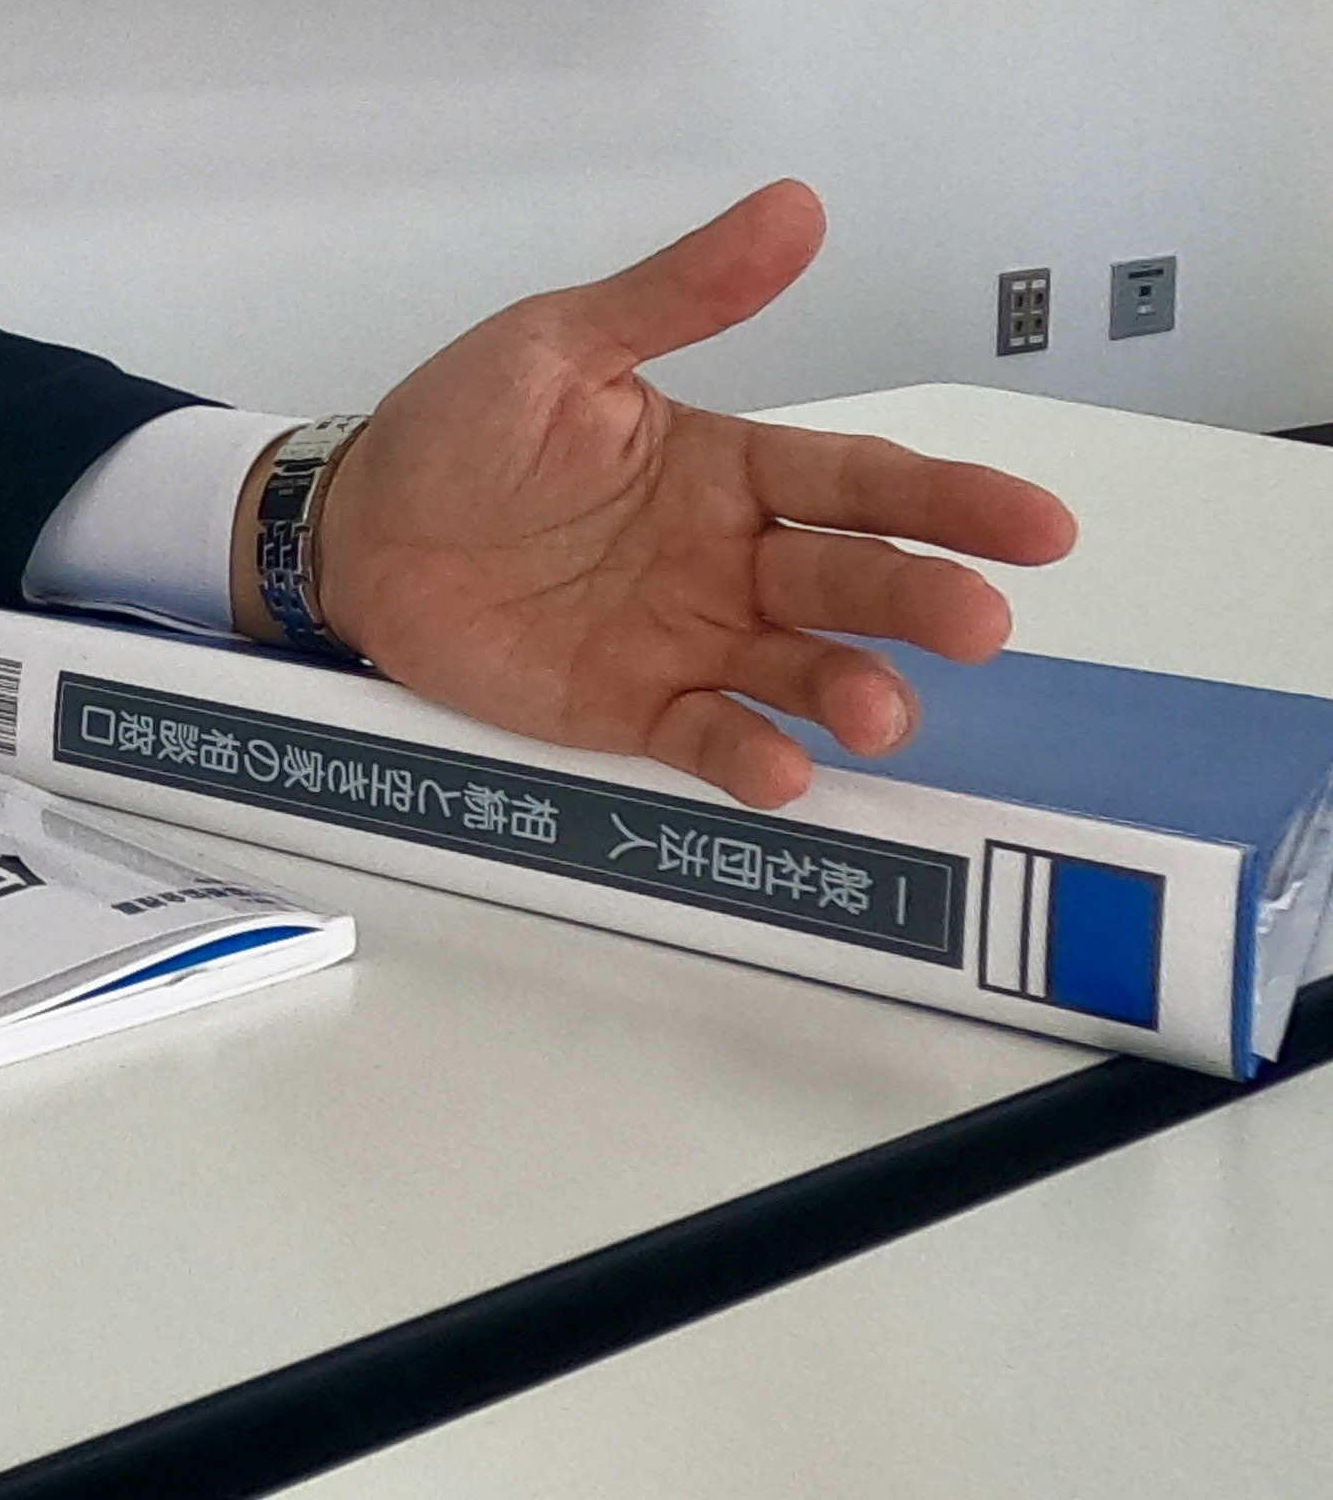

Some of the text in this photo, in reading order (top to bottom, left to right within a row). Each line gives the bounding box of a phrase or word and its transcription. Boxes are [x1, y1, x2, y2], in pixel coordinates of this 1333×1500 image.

[79, 703, 911, 928] 一般社団法人 相続と空き家の相談窓口
